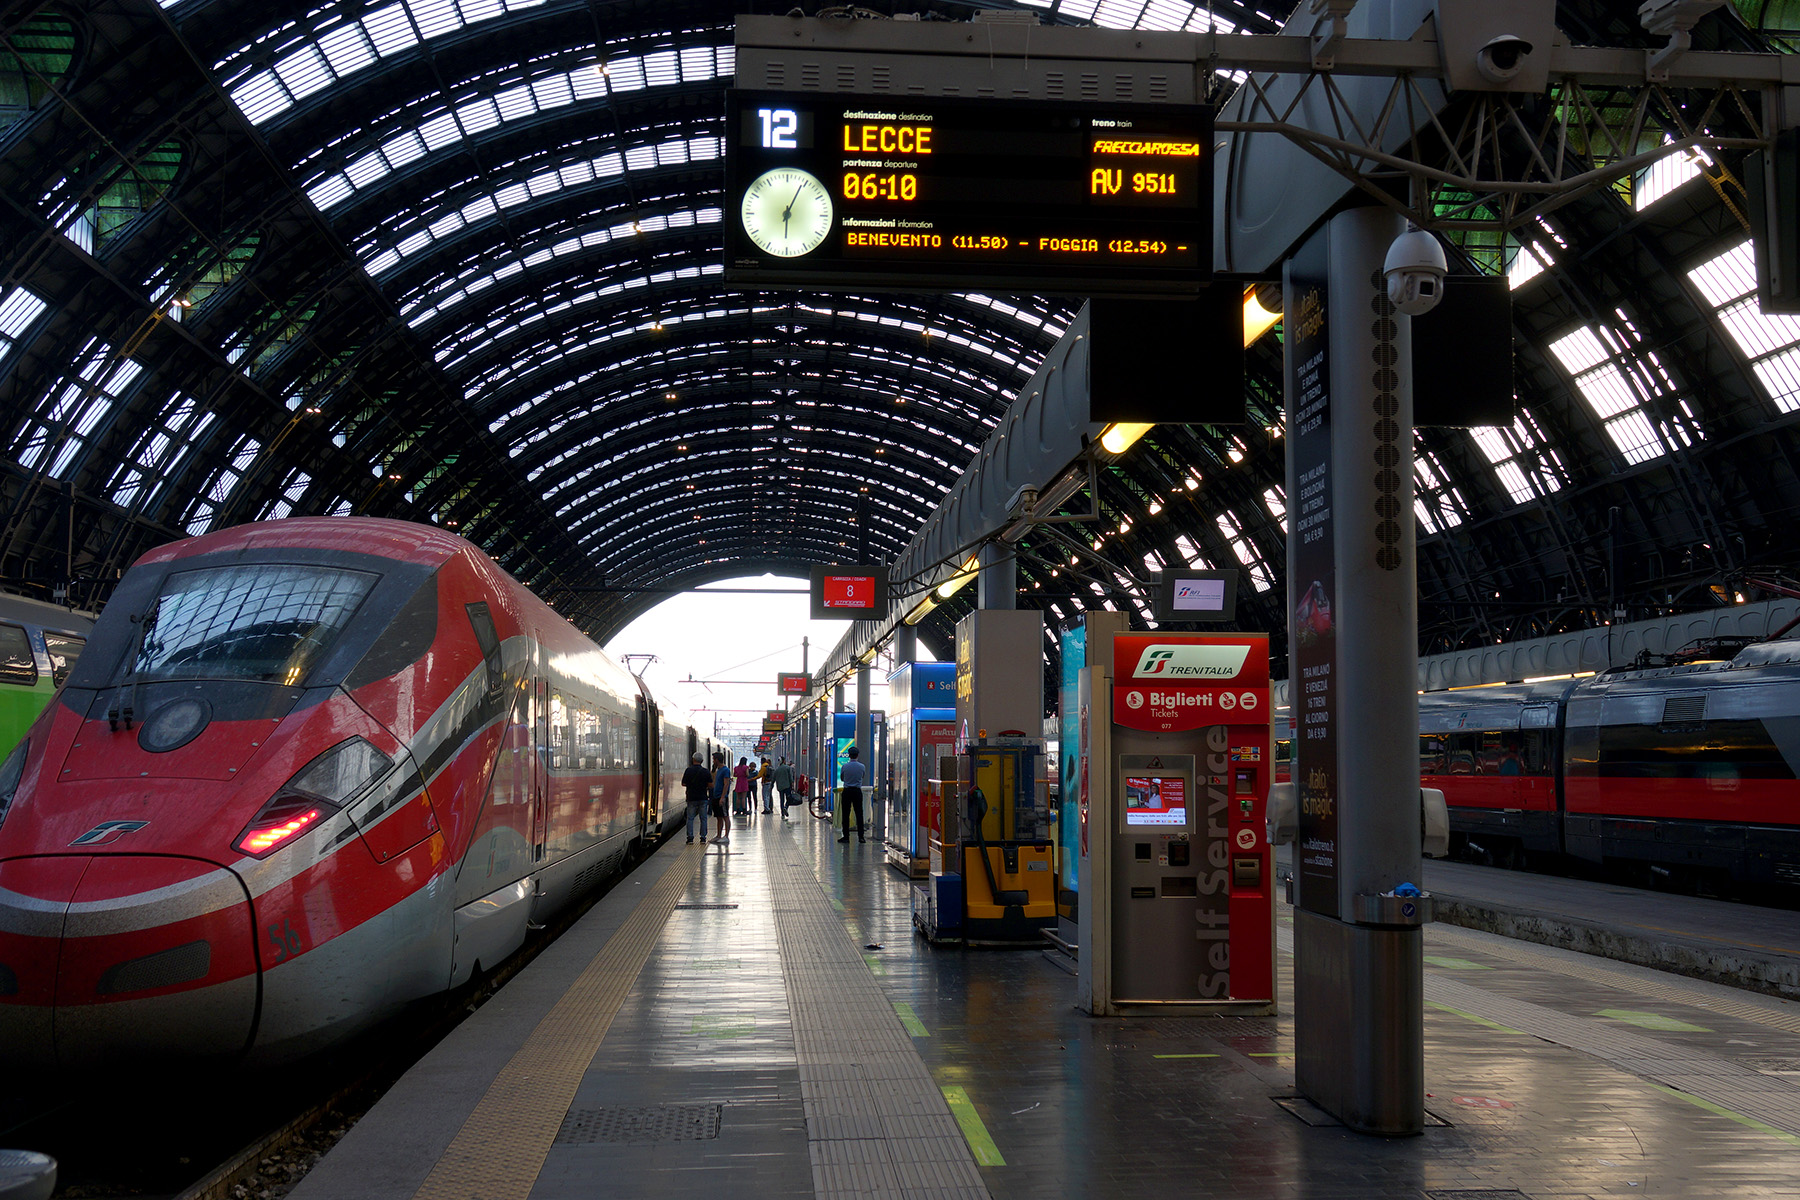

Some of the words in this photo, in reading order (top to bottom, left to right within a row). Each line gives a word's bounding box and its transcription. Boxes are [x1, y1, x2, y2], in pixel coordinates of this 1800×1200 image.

[843, 110, 897, 120] destinazione
[898, 112, 933, 121] destination
[1092, 119, 1116, 127] treno
[1117, 120, 1132, 128] train
[758, 109, 797, 149] 12
[844, 125, 932, 154] LECCE
[1093, 140, 1200, 156] FRECCIAROSSA
[843, 159, 882, 168] partenza
[884, 159, 918, 169] departure
[843, 172, 917, 200] 06:10
[1091, 168, 1122, 194] AV
[1132, 172, 1176, 194] 9511
[842, 217, 896, 227] informazioni
[897, 219, 933, 228] information
[847, 232, 942, 248] BENEVENTO
[952, 235, 1009, 249] (11.50)
[1039, 238, 1098, 252] FOGGIA
[1108, 240, 1167, 254] (12.54)
[847, 585, 854, 597] 8
[1170, 666, 1233, 675] TRENITALIA
[1311, 663, 1330, 677] MILANO
[1150, 692, 1212, 709] Biglietti
[1151, 708, 1179, 718] Tickets
[1309, 768, 1327, 789] italo
[1196, 725, 1229, 896] Service
[1310, 791, 1333, 820] magic
[268, 918, 301, 963] 56
[1195, 909, 1230, 998] Self
